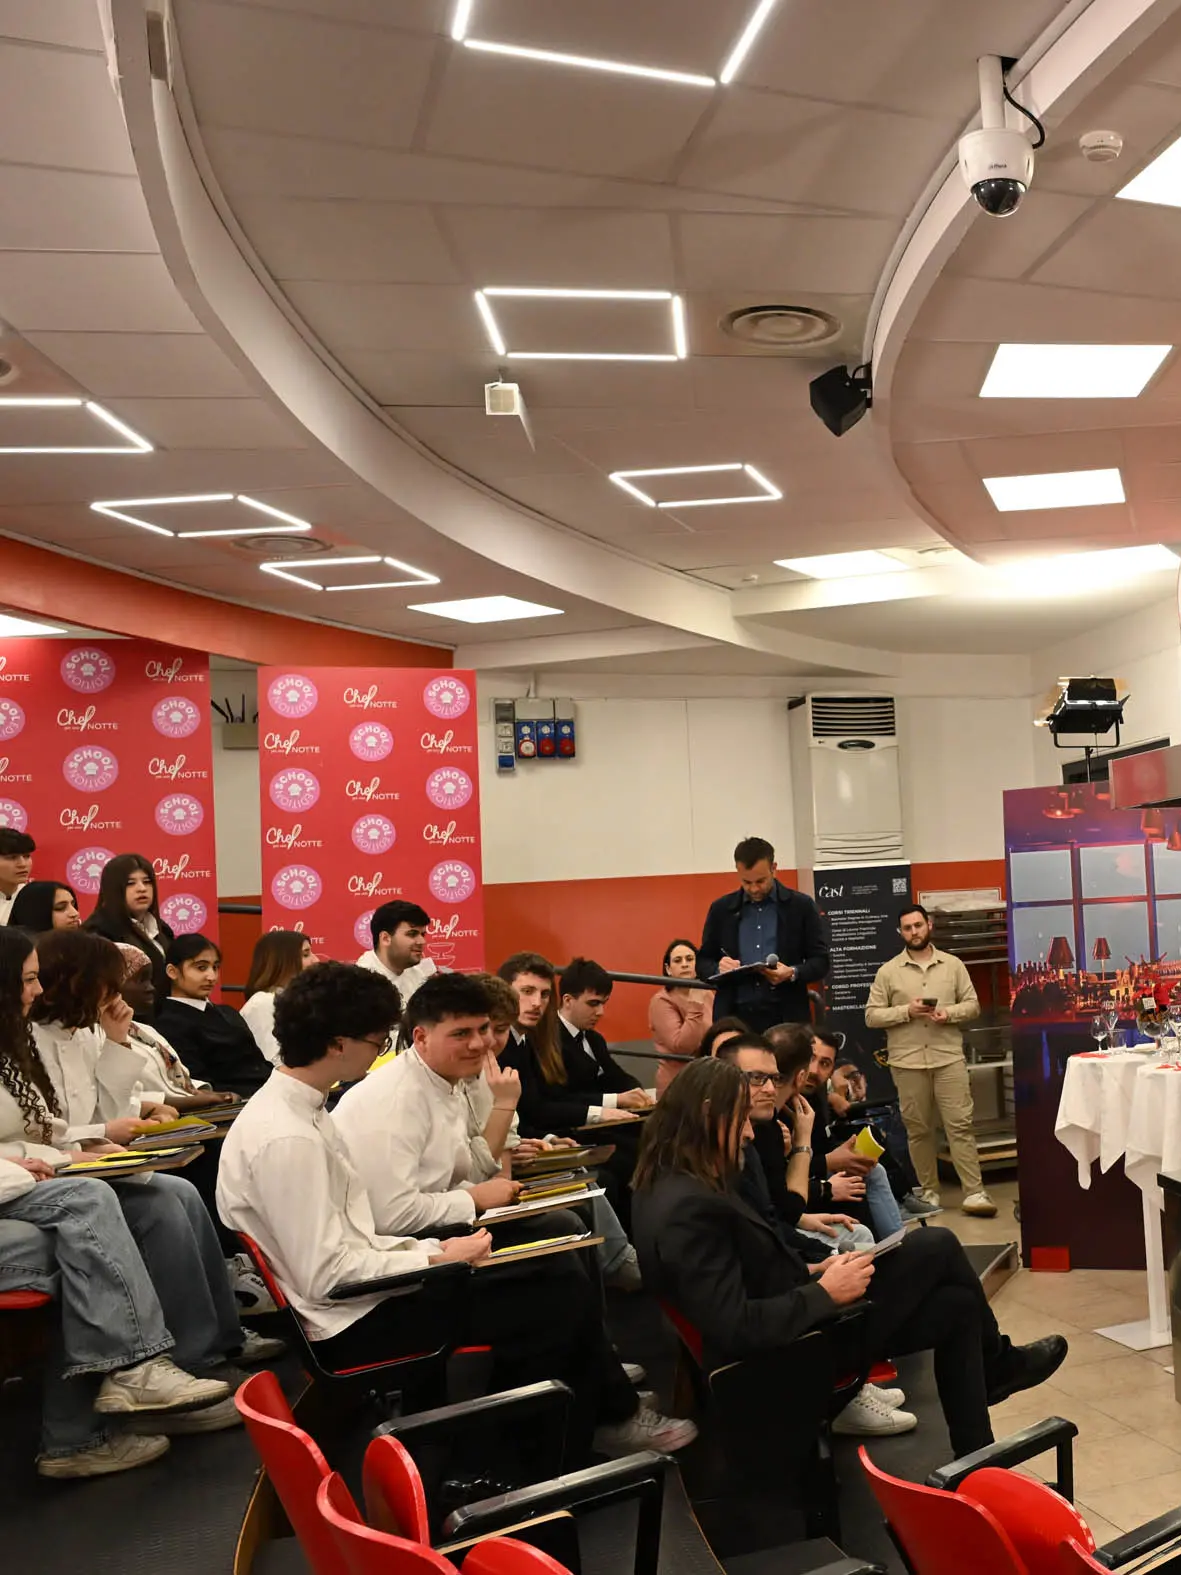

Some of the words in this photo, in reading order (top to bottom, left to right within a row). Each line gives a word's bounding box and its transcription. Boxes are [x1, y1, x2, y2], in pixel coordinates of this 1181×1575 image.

[66, 650, 111, 671] SCHOOL
[145, 657, 183, 683] Chef
[175, 674, 205, 682] NOTTE
[273, 678, 314, 699] SCHOOL
[343, 685, 378, 710] Chef
[428, 679, 466, 700] SCHOOL
[157, 699, 196, 719] SCHOOL
[369, 701, 398, 709] NOTTE
[57, 705, 96, 732] Chef
[264, 729, 300, 755] Chef
[354, 724, 390, 742] SCHOOL
[420, 730, 454, 754] Chef
[292, 746, 320, 754] NOTTE
[446, 745, 473, 753] NOTTE
[69, 749, 114, 771] SCHOOL
[149, 754, 186, 781] Chef
[0, 774, 32, 782] NOTTE
[178, 771, 208, 779] NOTTE
[275, 771, 316, 792] SCHOOL
[430, 769, 469, 790] SCHOOL
[345, 777, 380, 802] Chef
[372, 792, 400, 800] NOTTE
[160, 797, 199, 816] SCHOOL
[60, 804, 99, 832] Chef
[90, 821, 122, 829] NOTTE
[356, 818, 393, 837] SCHOOL
[266, 823, 302, 850] Chef
[294, 839, 322, 848] NOTTE
[423, 820, 457, 846] Chef
[448, 836, 475, 844] NOTTE
[72, 850, 109, 871] SCHO
[181, 870, 211, 878] NOTTE
[277, 868, 318, 889] SCHOOL
[432, 863, 471, 884] SCHOOL
[348, 872, 383, 897] Chef
[374, 887, 402, 895] NOTTE
[164, 896, 203, 917] SCHOOL
[310, 936, 325, 945] TTE
